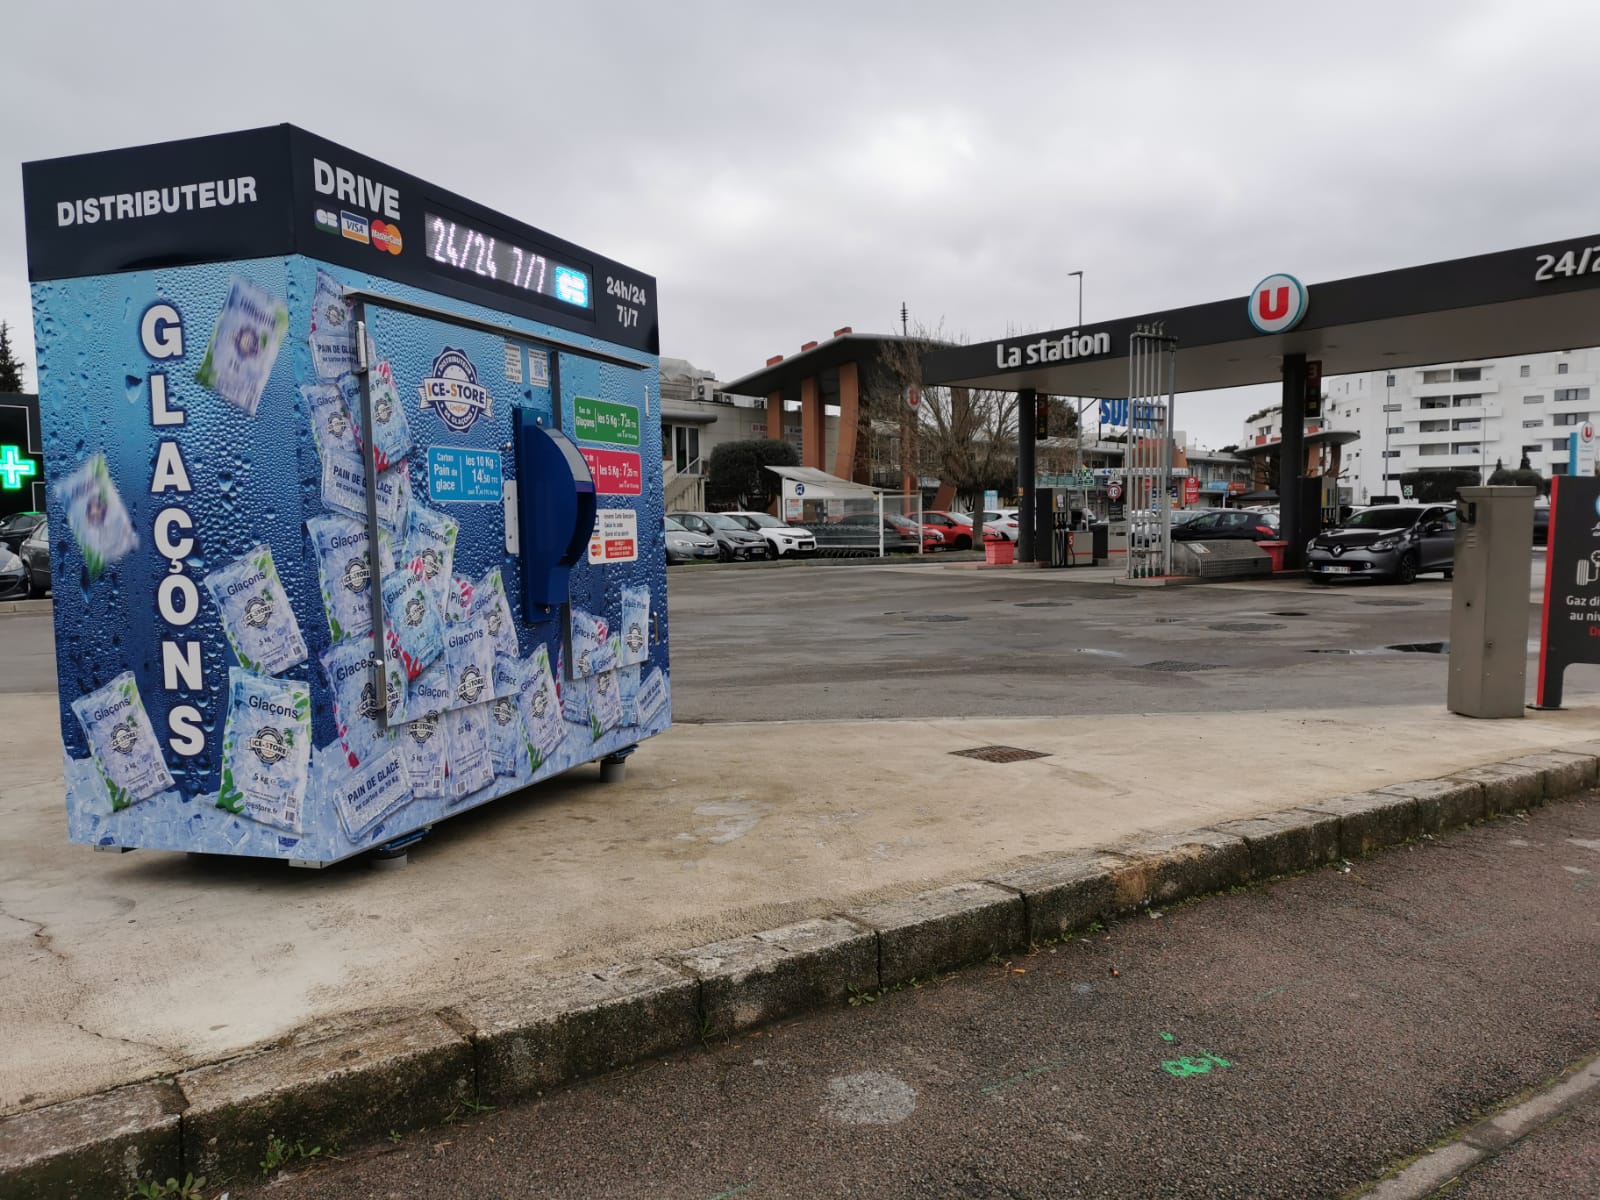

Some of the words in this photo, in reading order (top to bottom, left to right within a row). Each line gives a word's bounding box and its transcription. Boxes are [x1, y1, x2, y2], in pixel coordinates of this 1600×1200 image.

[313, 158, 400, 220] DRIVE
[57, 176, 257, 227] DISTRIBUTEUR
[346, 220, 364, 234] VISA
[432, 216, 497, 279] 24/24
[512, 245, 546, 294] 7/7
[606, 276, 646, 306] 24h/24
[1259, 286, 1290, 321] U
[617, 305, 639, 328] 7j/7
[996, 344, 1022, 369] La
[1026, 331, 1111, 365] station
[426, 383, 485, 405] ICE-STORE
[597, 412, 605, 425] les
[605, 414, 610, 425] 5
[434, 464, 449, 476] Pain
[465, 455, 475, 466] les
[476, 456, 484, 467] 10
[485, 457, 494, 469] Kg
[333, 466, 350, 481] PAIN
[352, 473, 360, 485] DE
[436, 479, 456, 493] glace
[141, 303, 206, 757] GLAÇONS
[331, 531, 369, 549] Glaçons
[419, 522, 448, 543] Glaçons
[227, 572, 266, 597] Glaçons
[1566, 595, 1587, 606] Gaz
[1570, 612, 1583, 620] au
[448, 629, 484, 648] Glaçons
[94, 697, 130, 721] Glaçons
[249, 695, 299, 720] Glaçons
[251, 739, 287, 755] ICE-STORE
[347, 784, 366, 804] PAIN
[366, 776, 376, 790] DE
[377, 759, 400, 782] GLACE
